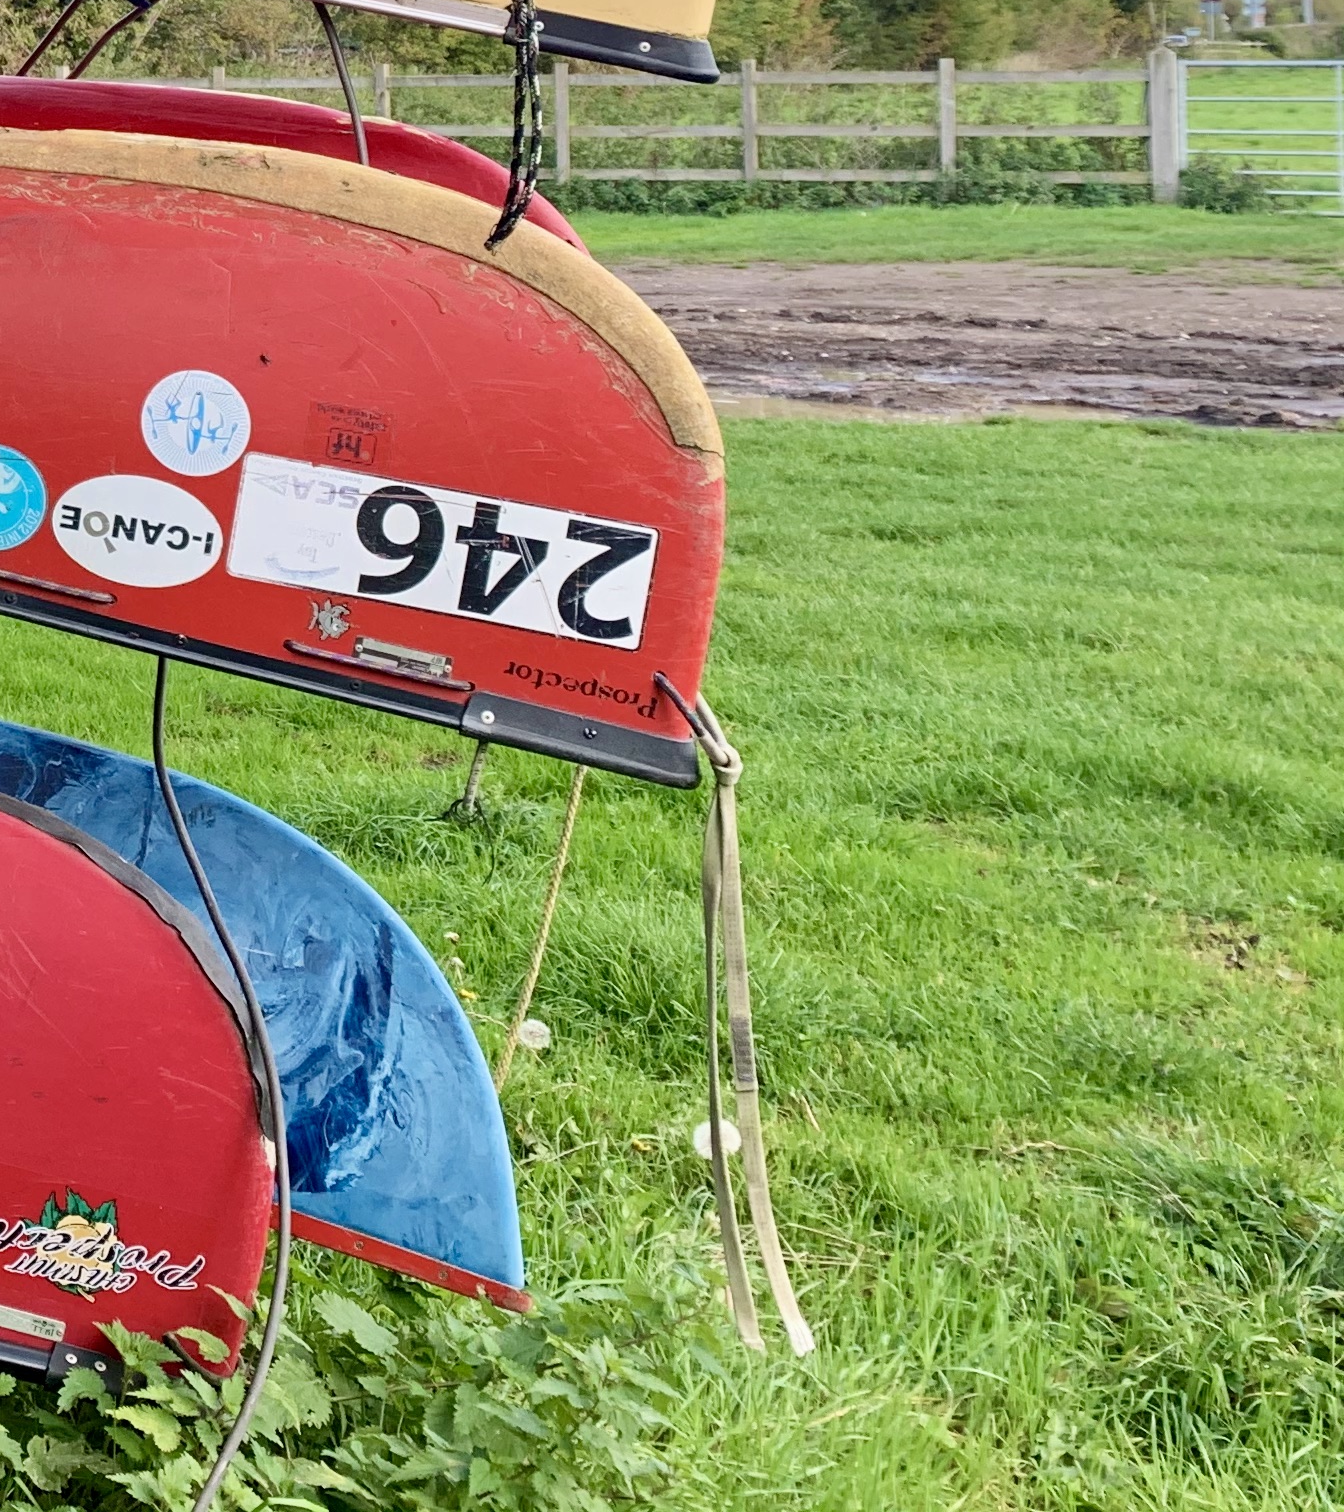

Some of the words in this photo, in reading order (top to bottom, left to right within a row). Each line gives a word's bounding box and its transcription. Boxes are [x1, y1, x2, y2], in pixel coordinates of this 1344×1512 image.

[16, 508, 41, 534] 2012
[355, 483, 653, 640] 246
[503, 659, 660, 720] Prospector
